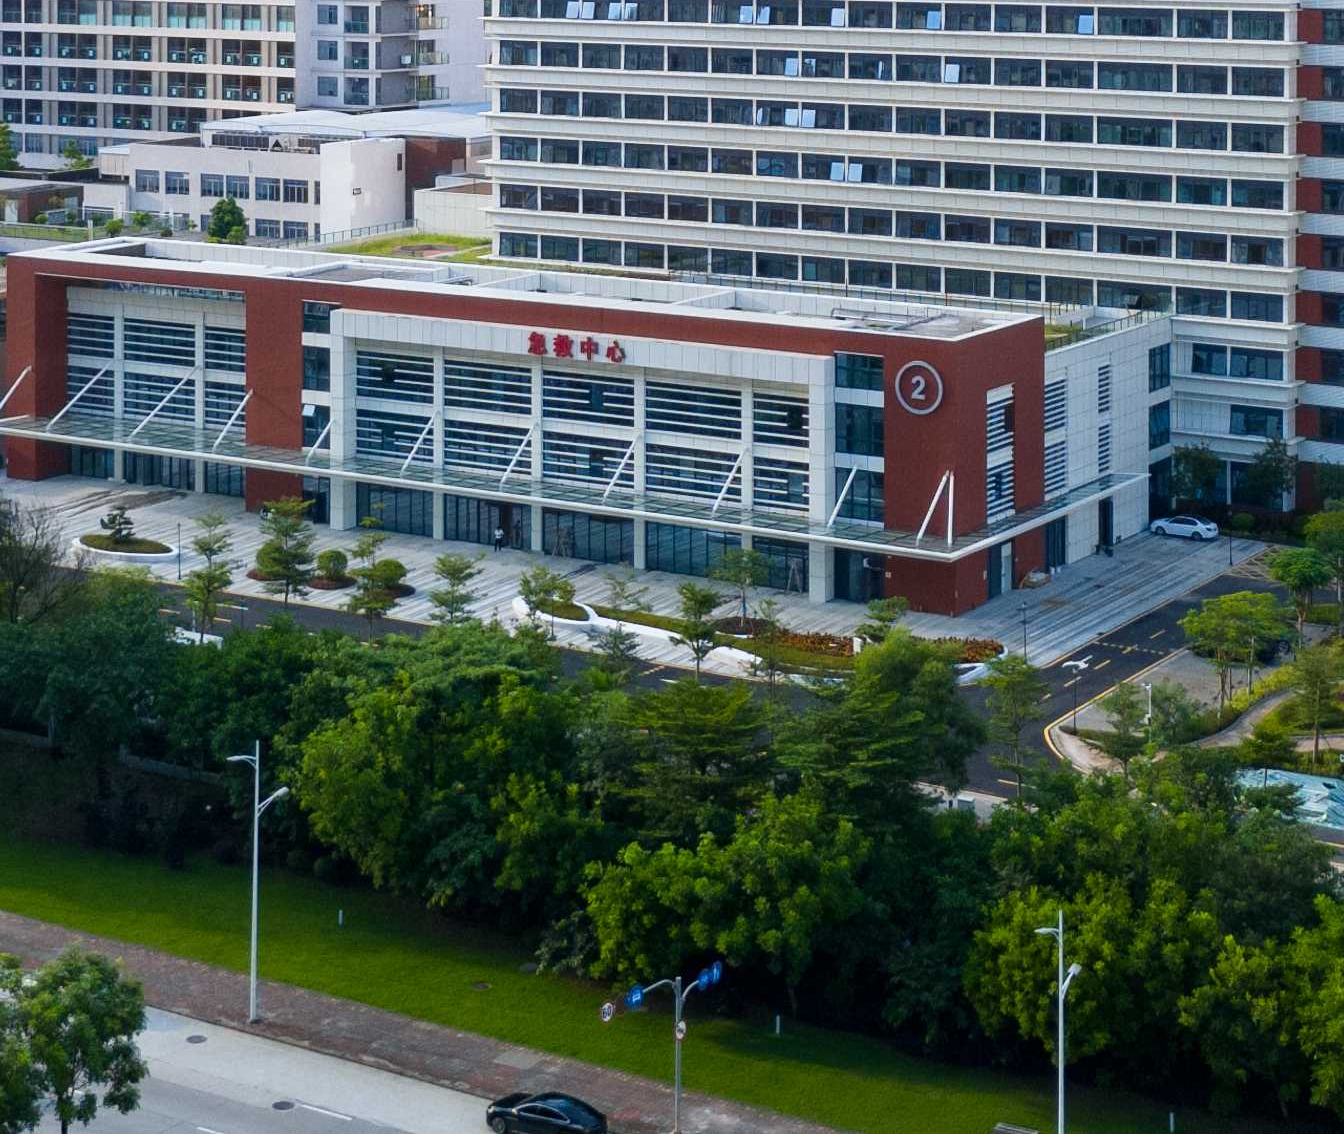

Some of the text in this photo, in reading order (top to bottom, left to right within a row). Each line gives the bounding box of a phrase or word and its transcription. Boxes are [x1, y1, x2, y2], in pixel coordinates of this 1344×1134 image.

[528, 331, 626, 362] 急救中心
[911, 375, 926, 400] 2
